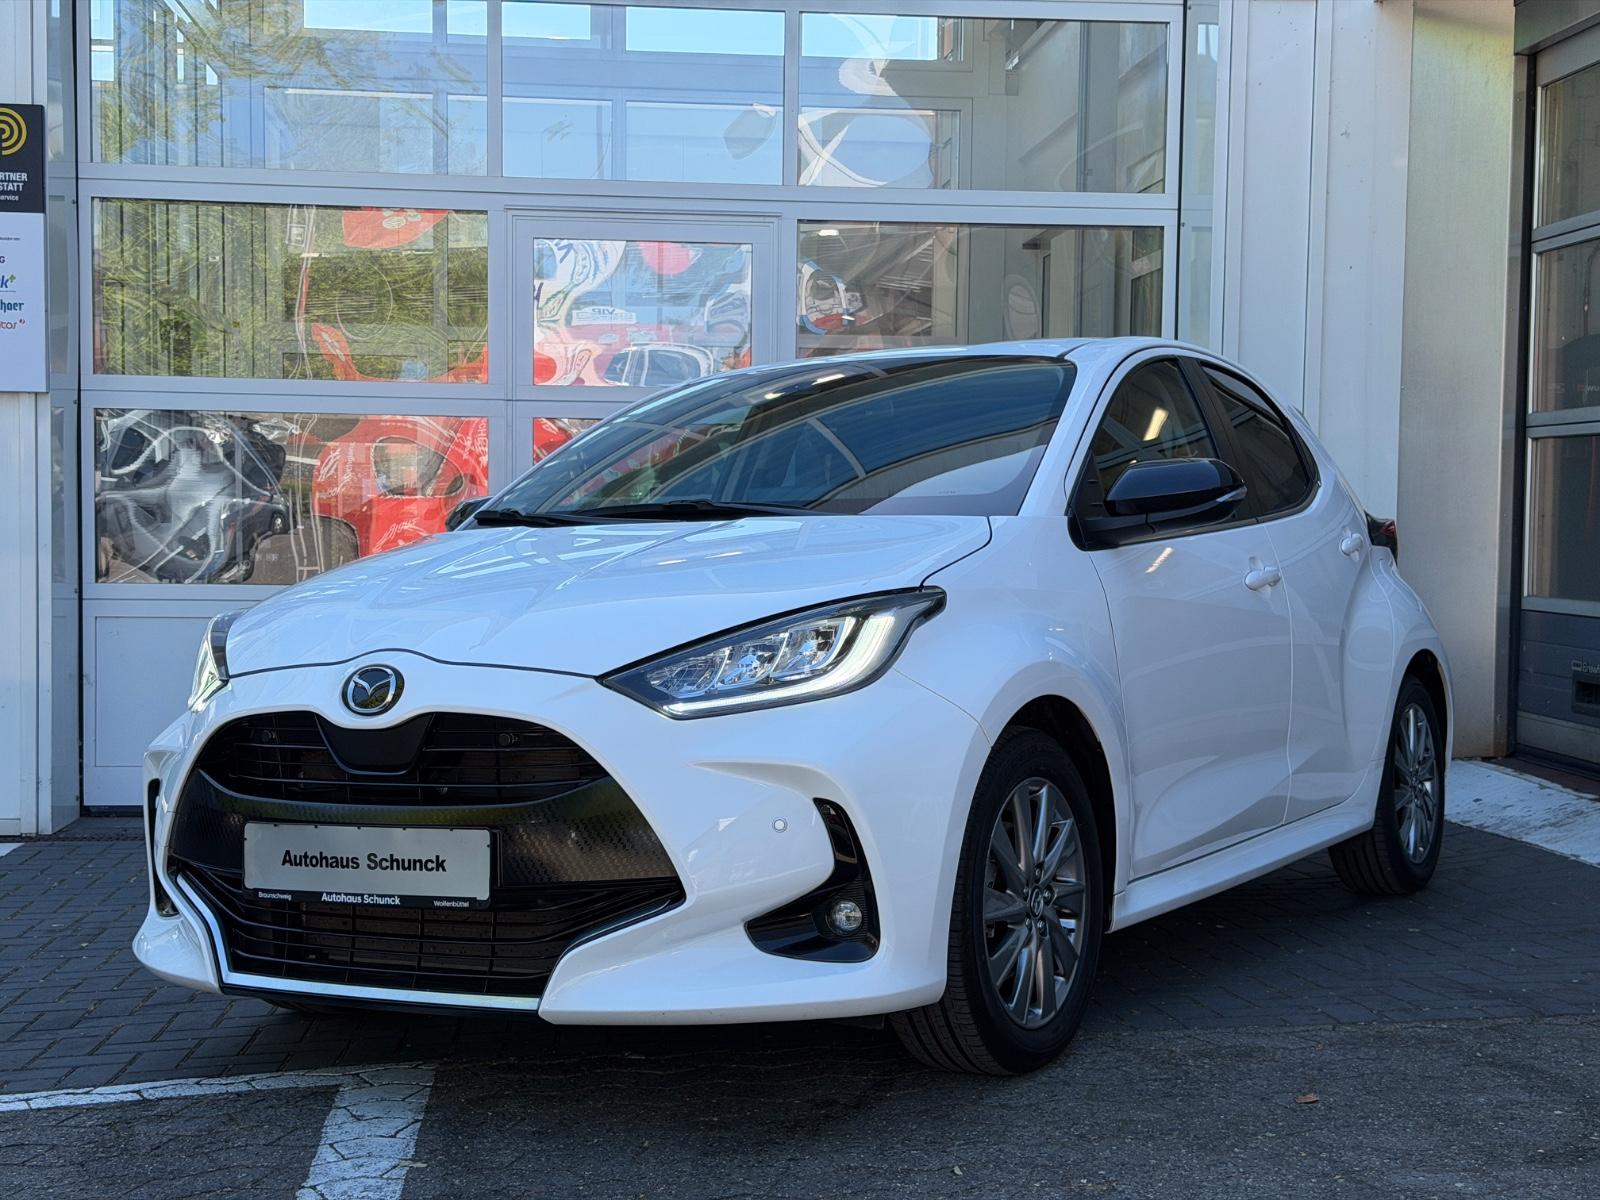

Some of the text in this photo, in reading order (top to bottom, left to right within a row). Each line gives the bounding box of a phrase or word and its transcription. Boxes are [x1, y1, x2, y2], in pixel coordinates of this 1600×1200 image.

[281, 849, 447, 872] Autohaus Schunck
[321, 892, 401, 905] Autohaus Schunck
